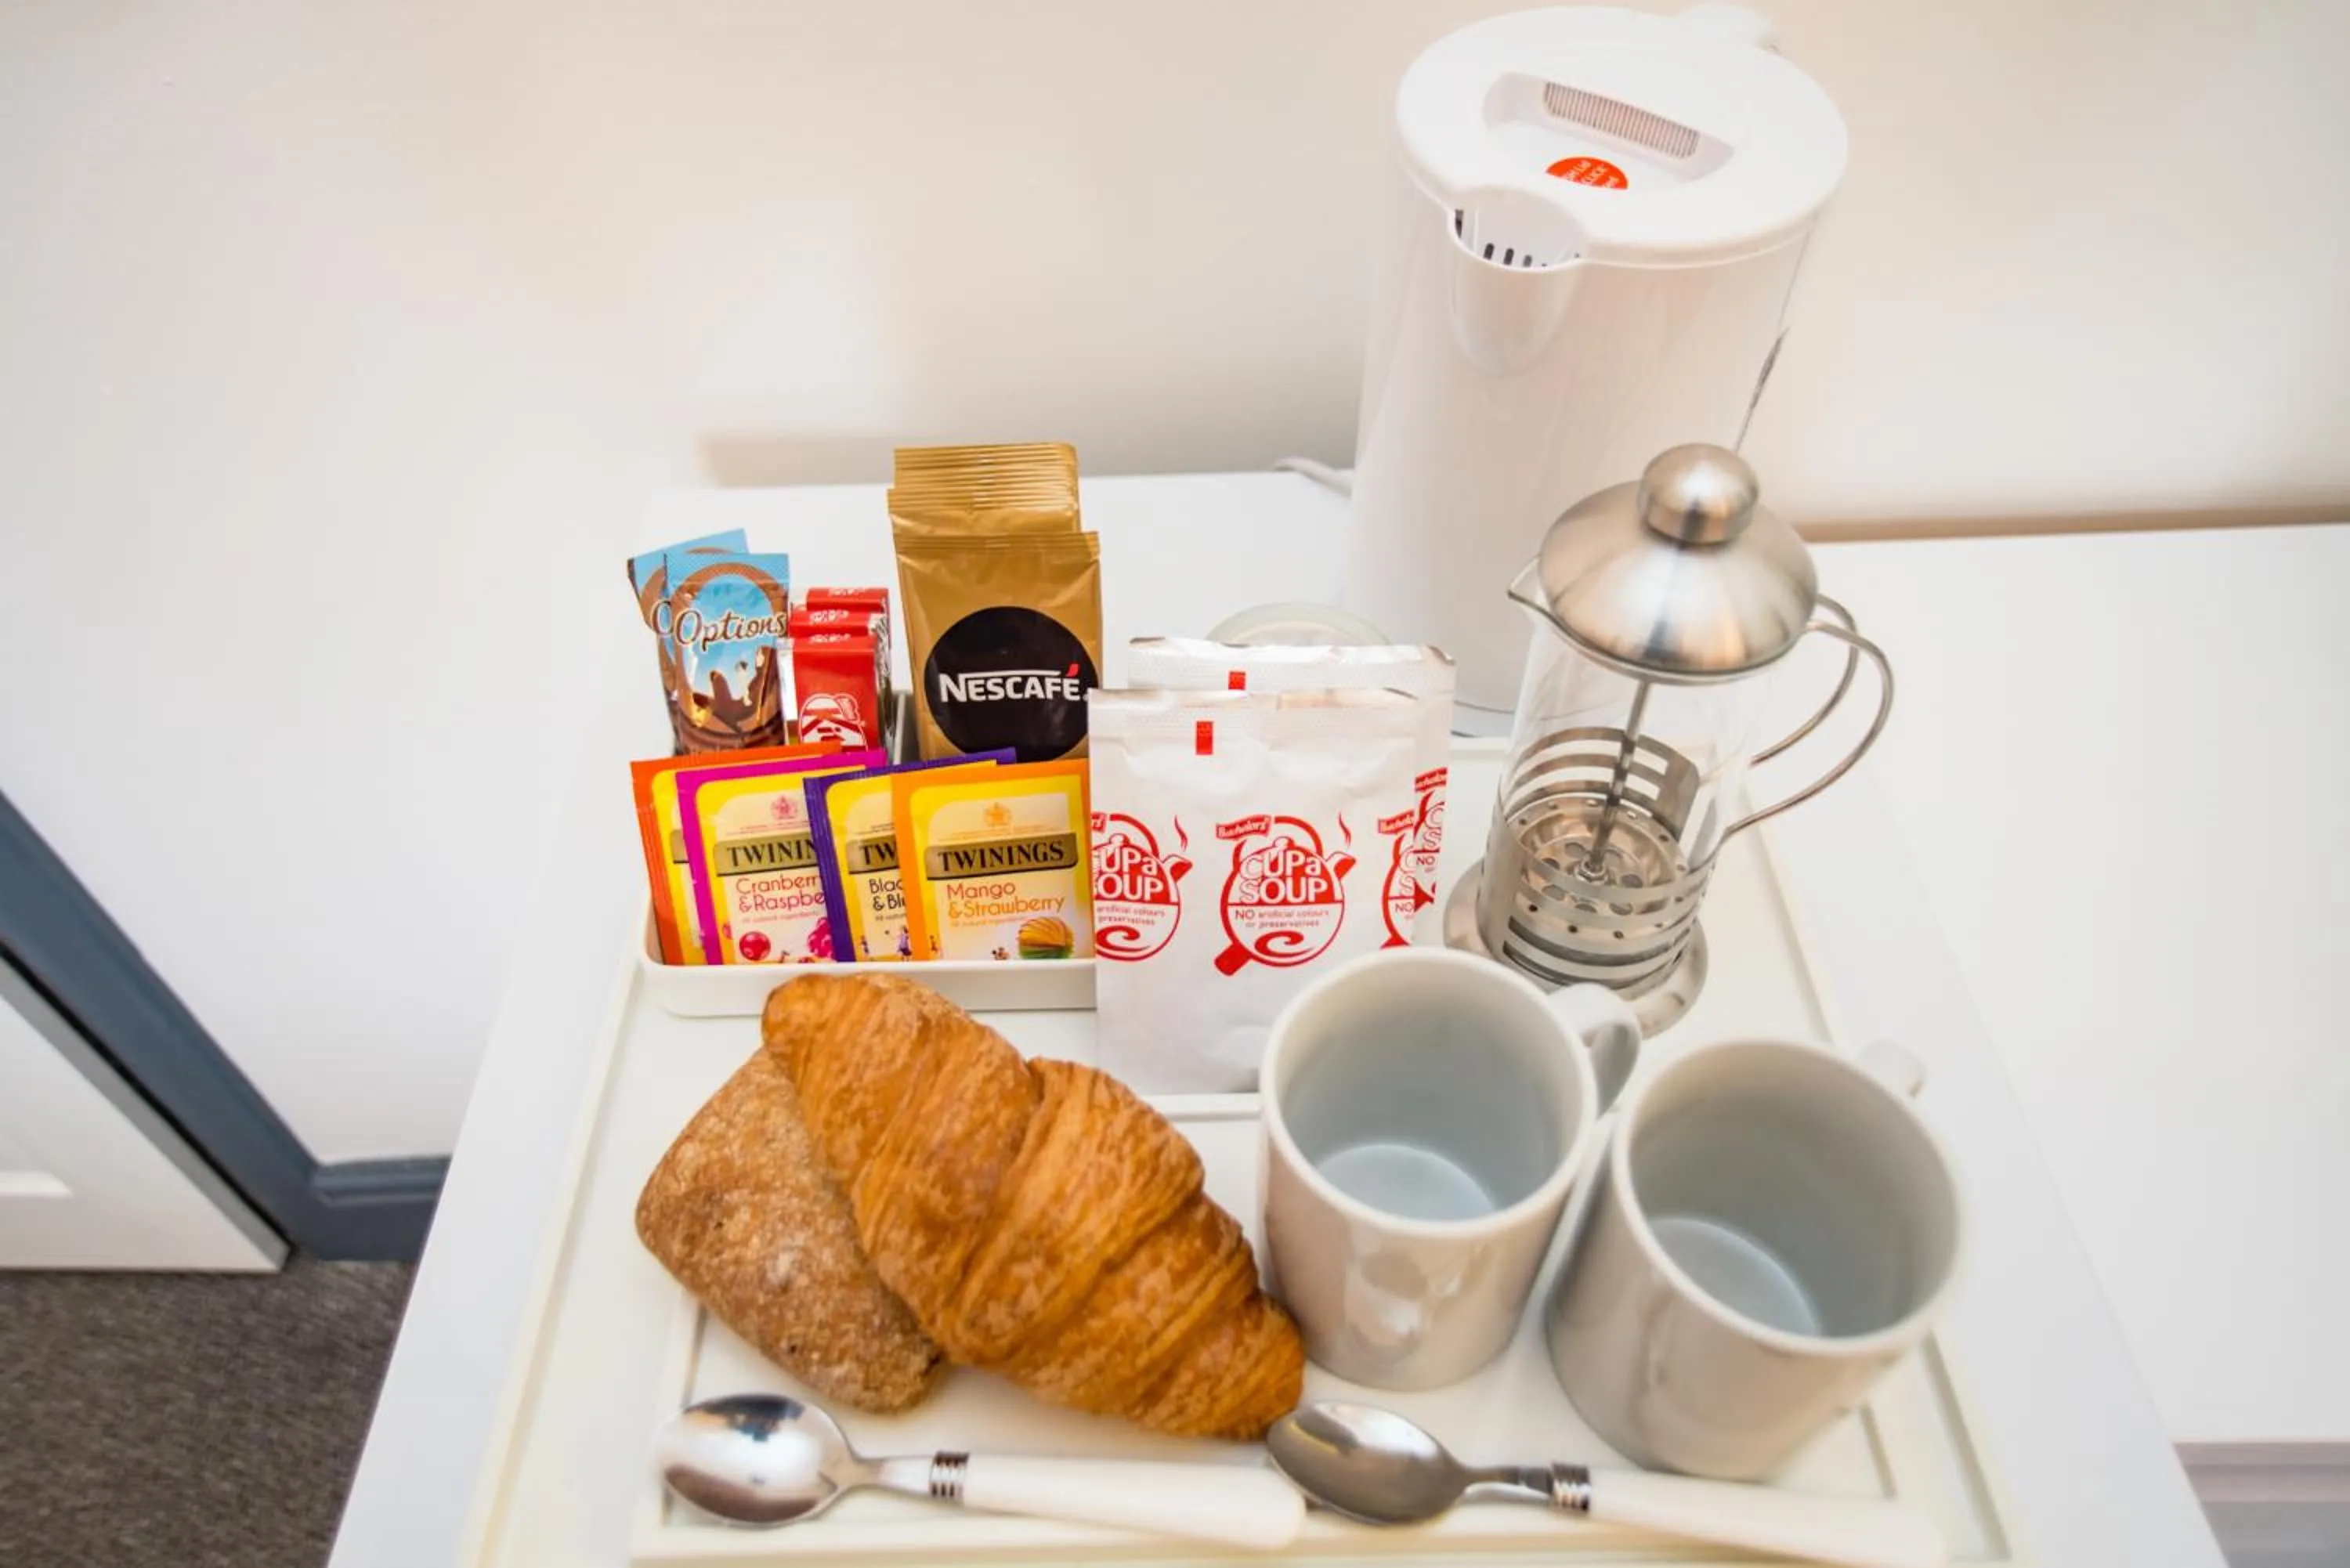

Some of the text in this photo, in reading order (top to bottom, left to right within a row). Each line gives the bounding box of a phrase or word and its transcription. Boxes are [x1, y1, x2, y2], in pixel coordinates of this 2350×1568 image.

[674, 609, 788, 652] Options
[726, 839, 815, 867] TWININ
[938, 840, 1065, 872] TWININGS
[1415, 854, 1436, 866] NO
[736, 874, 819, 894] Cranberr
[869, 878, 903, 894] Blac
[946, 882, 1016, 900] Mango
[1239, 877, 1329, 904] SOUP
[753, 890, 825, 912] Raspbe
[1235, 909, 1254, 919] NO
